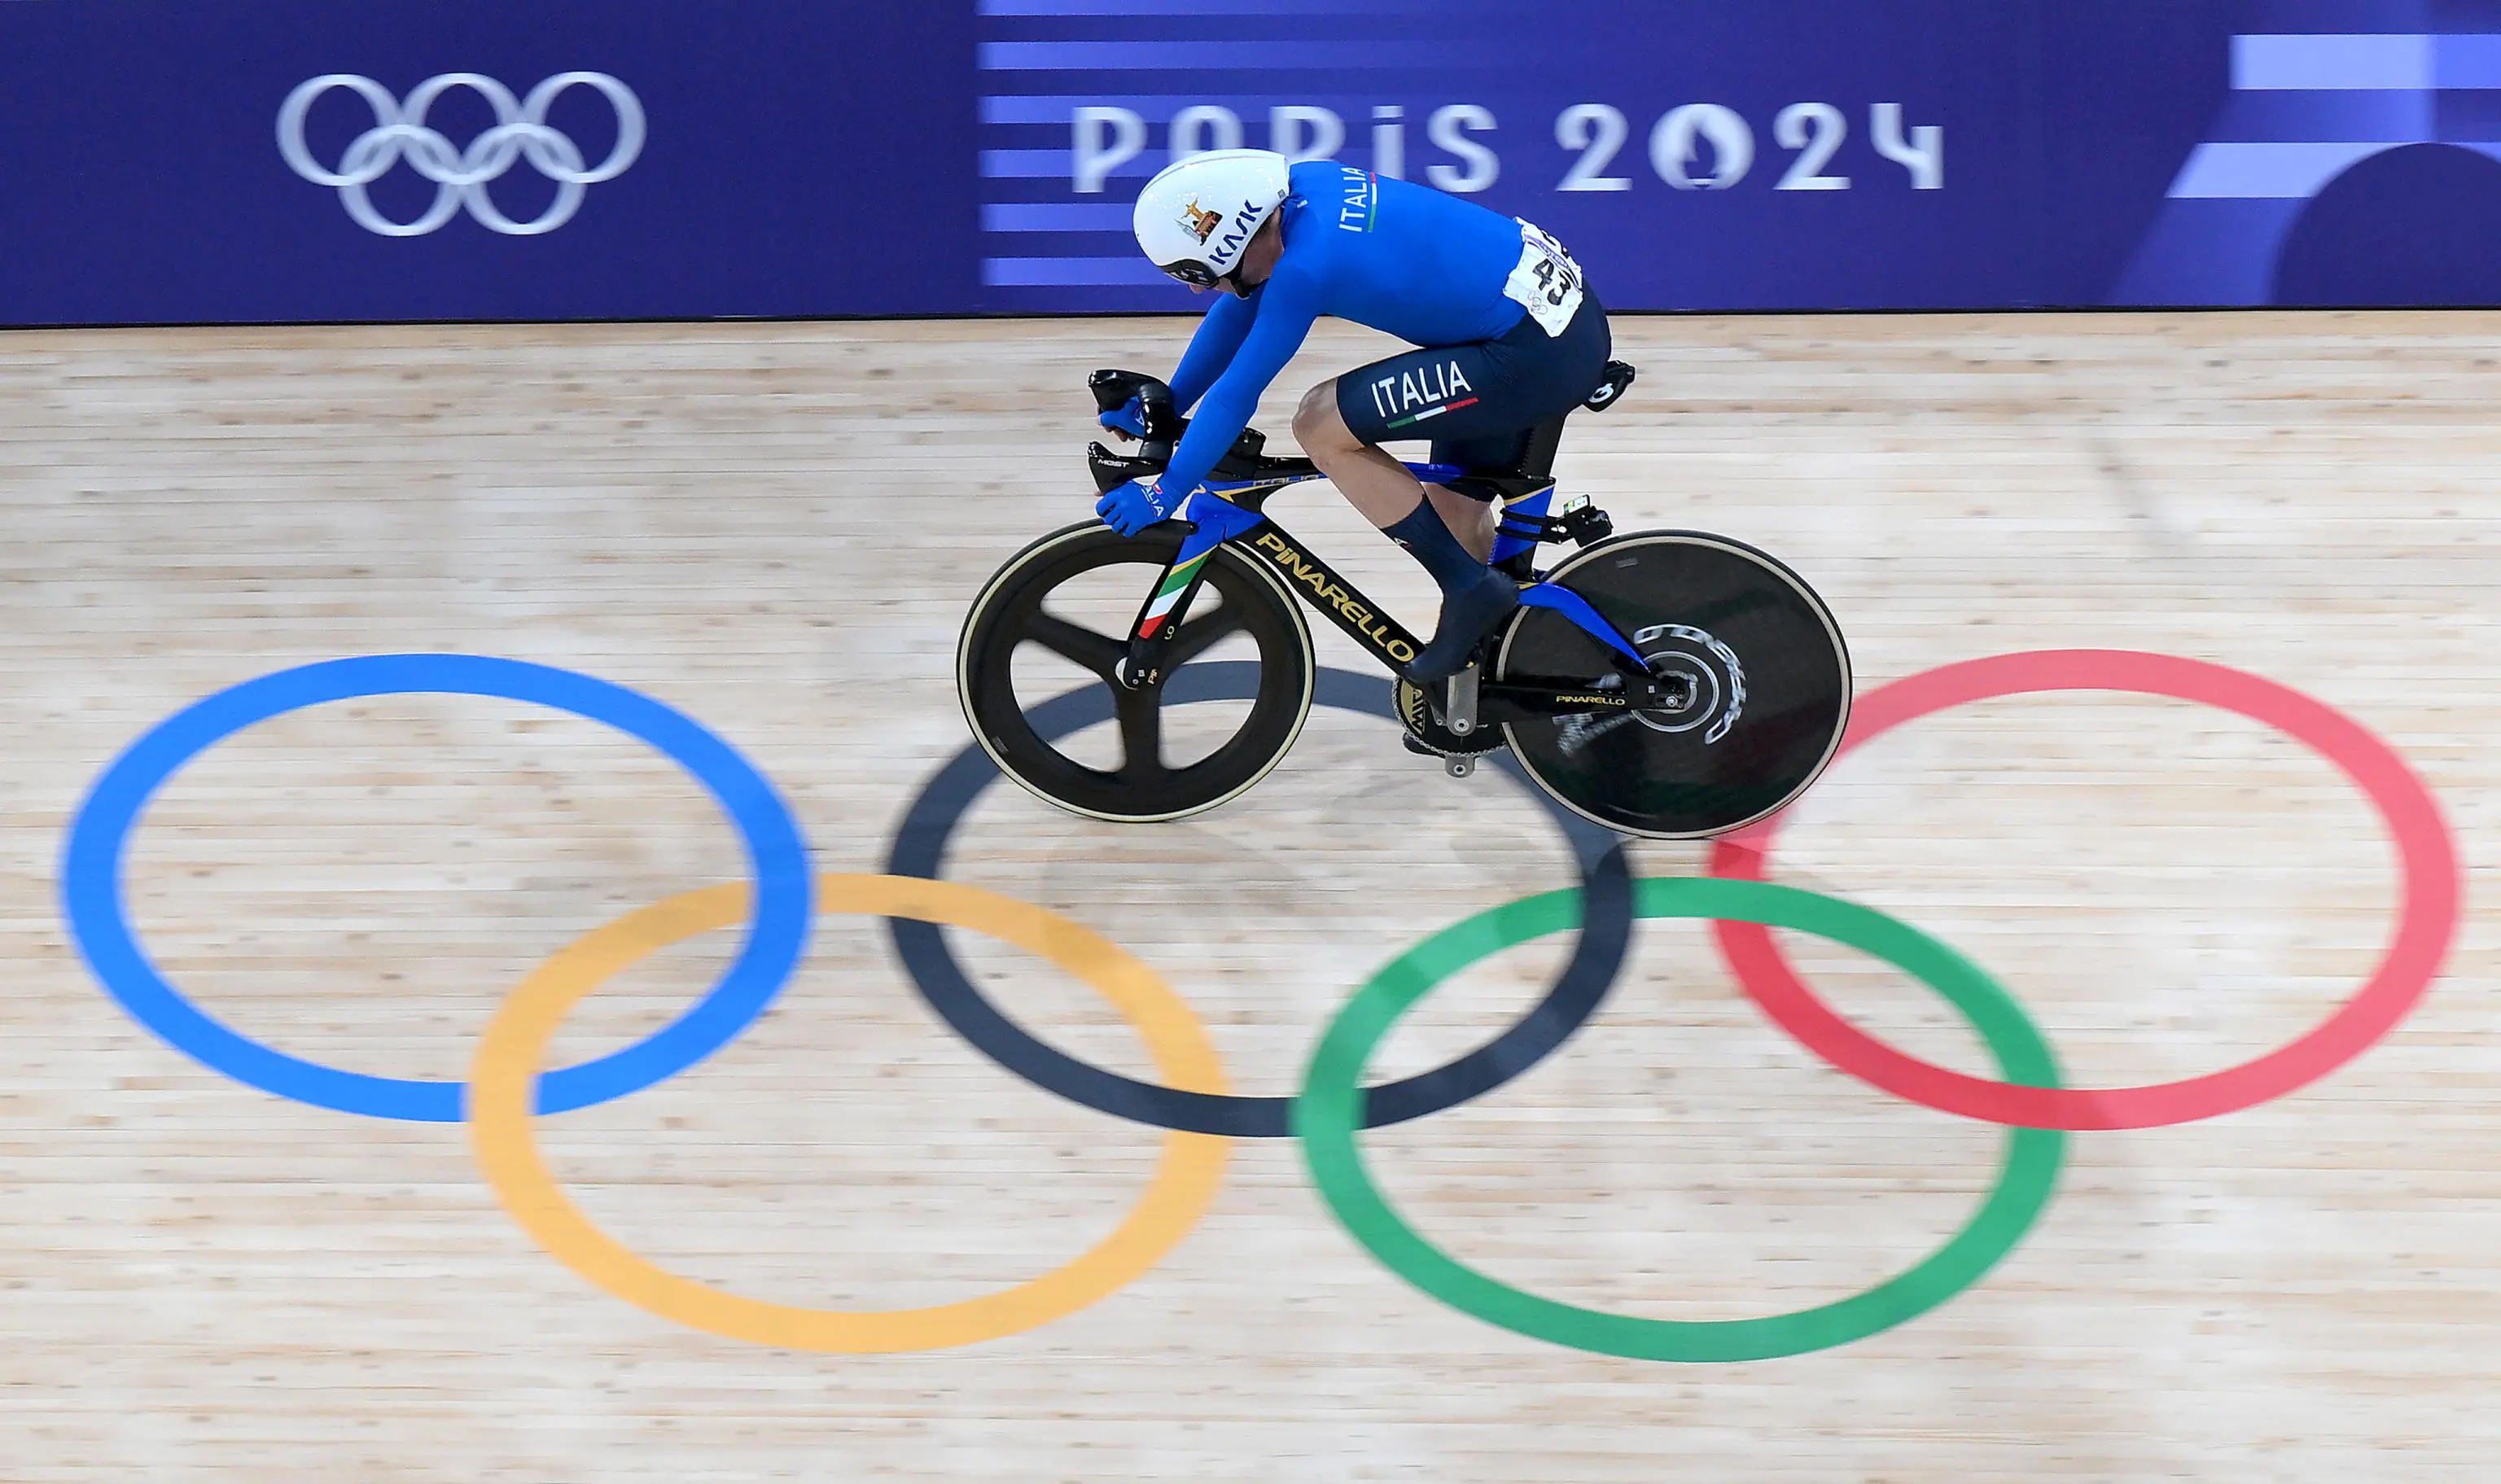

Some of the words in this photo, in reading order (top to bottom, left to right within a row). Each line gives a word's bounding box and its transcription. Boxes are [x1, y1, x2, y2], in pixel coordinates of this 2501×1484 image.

[1553, 102, 1944, 191] 2024
[1338, 167, 1368, 232] ITALIA
[1208, 199, 1264, 265] KASK
[1532, 258, 1571, 306] 43
[1371, 361, 1473, 418] ITALIA
[1097, 458, 1129, 468] MOST
